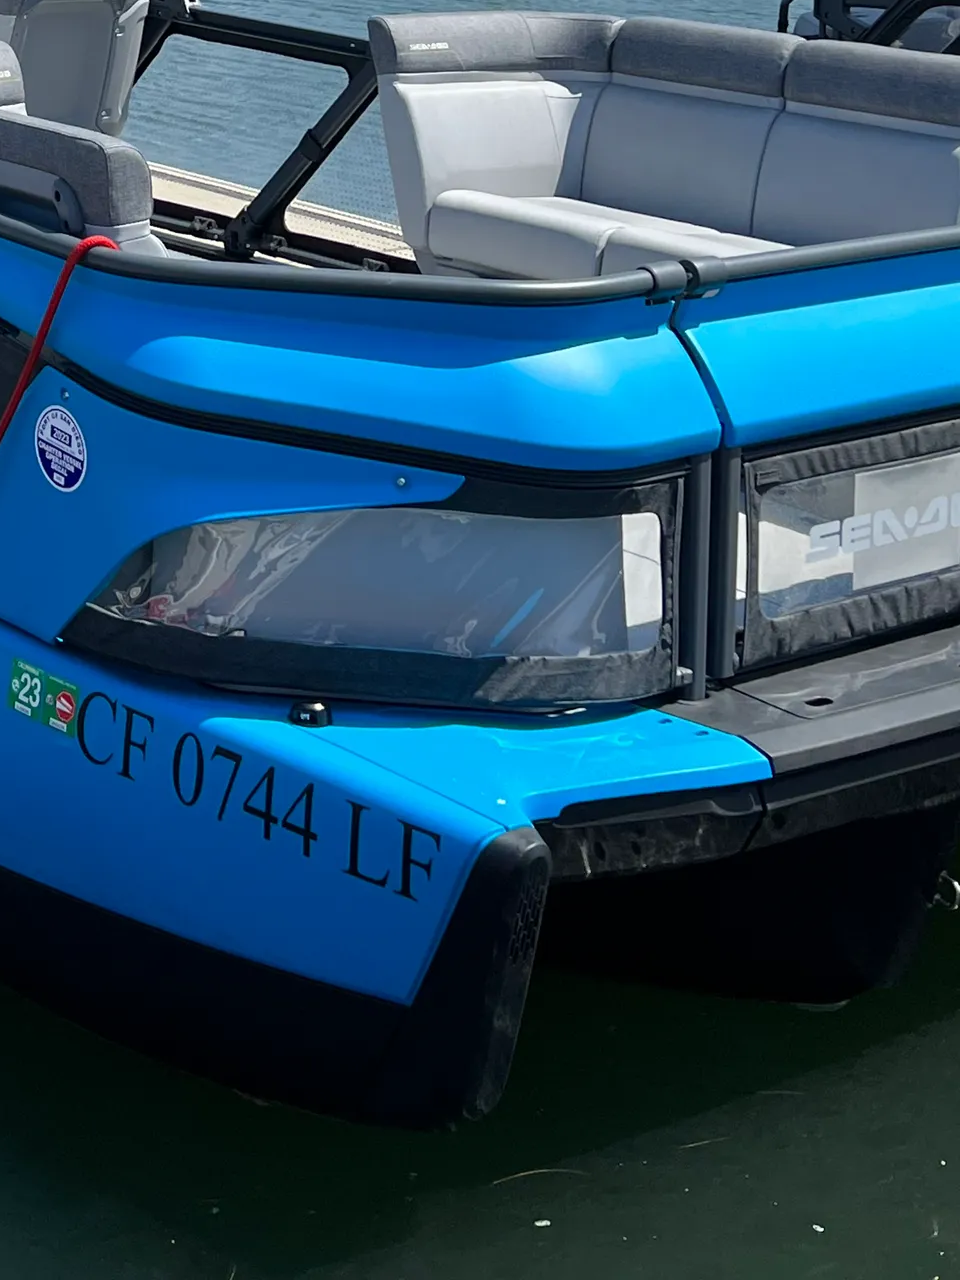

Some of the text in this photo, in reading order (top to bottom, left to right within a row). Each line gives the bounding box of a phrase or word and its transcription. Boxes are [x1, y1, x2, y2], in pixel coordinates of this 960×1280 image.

[60, 413, 71, 426] SAN
[71, 426, 83, 455] DIEGO
[18, 672, 41, 707] 23
[76, 691, 441, 902] CF 0744 LF
